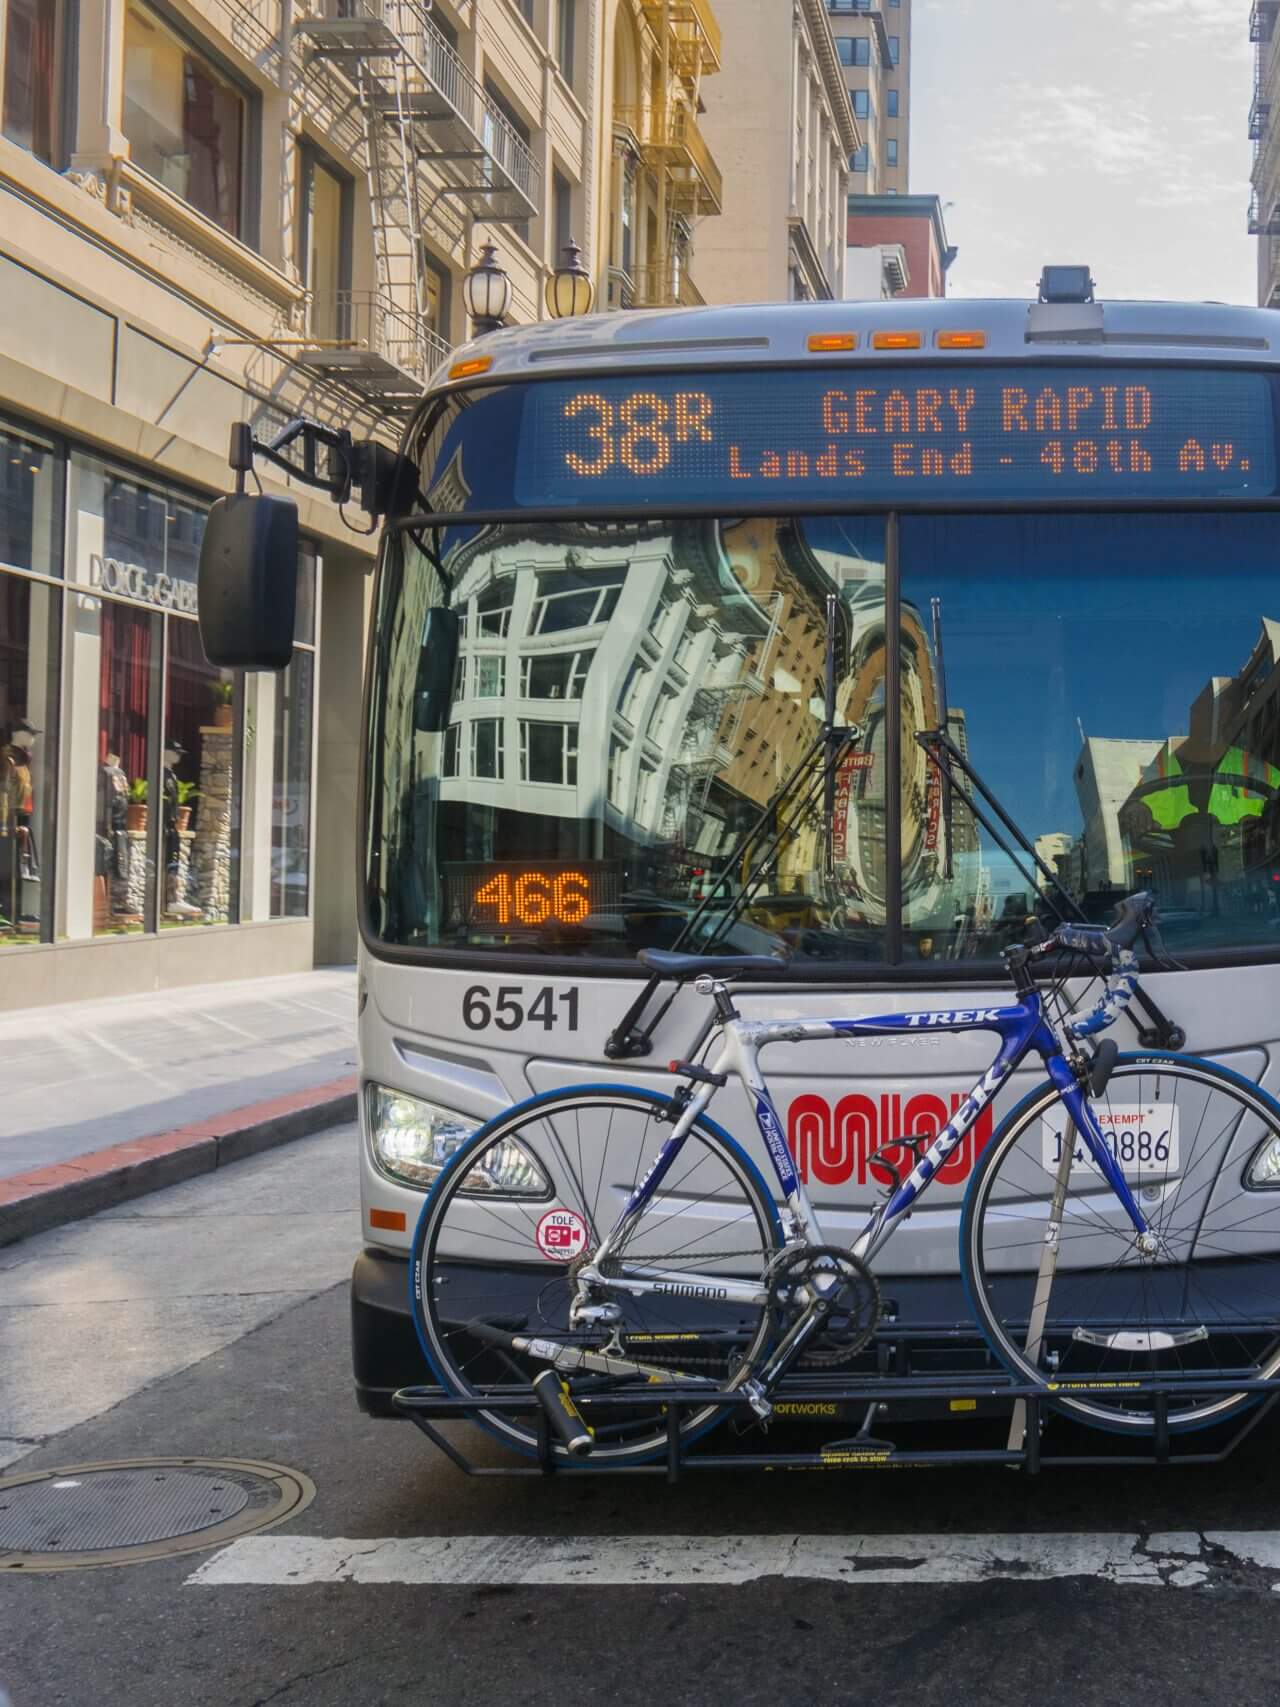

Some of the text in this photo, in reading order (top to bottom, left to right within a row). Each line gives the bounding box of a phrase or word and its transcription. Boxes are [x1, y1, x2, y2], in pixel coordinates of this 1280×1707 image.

[822, 386, 1153, 436] GEARY RAPID
[563, 391, 713, 478] 38R
[729, 443, 866, 481] Lands
[892, 441, 973, 478] End
[1040, 438, 1153, 475] 48th
[1178, 438, 1252, 473] Av.
[89, 553, 148, 602] DOLCE
[474, 872, 590, 924] 466
[462, 985, 579, 1032] 6541
[905, 1009, 1001, 1027] TREK
[902, 1064, 1010, 1192] TREK
[1098, 1114, 1146, 1124] EXEMPT
[551, 1215, 576, 1226] TOLE
[653, 1283, 727, 1299] SHIMANO
[773, 1403, 836, 1415] ortworks
